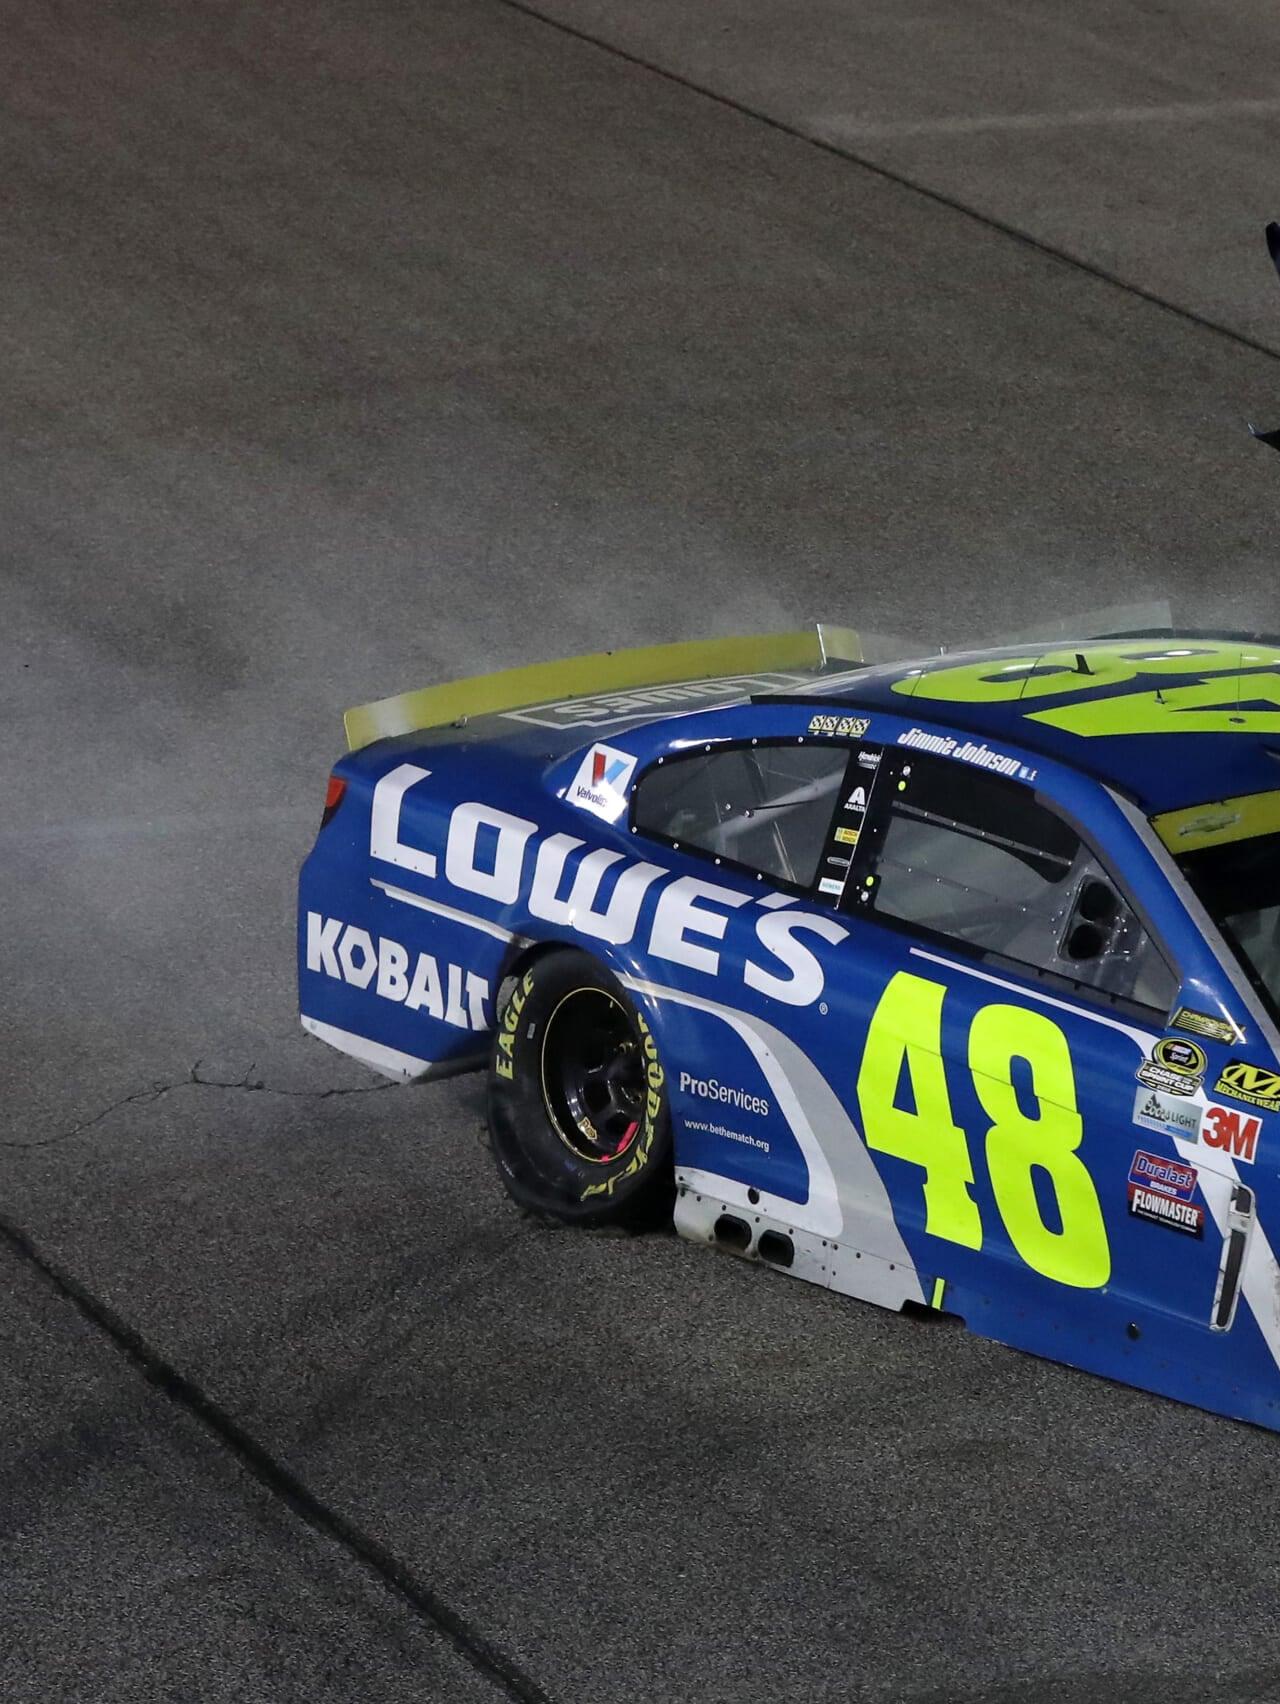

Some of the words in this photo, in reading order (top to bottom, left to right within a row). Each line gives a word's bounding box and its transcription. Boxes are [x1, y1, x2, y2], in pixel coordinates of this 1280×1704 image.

[554, 678, 782, 718] LOWE'S
[897, 727, 958, 756] Jimmie
[952, 742, 1022, 776] Johnson
[576, 785, 609, 808] Valvoli
[370, 763, 850, 1007] LOWE'S
[307, 911, 490, 1032] KOBALT
[495, 967, 536, 1080] EAGLE
[680, 1071, 770, 1116] ProServices
[1141, 1070, 1175, 1088] SPRINT
[1174, 1079, 1194, 1092] CUP
[1149, 1066, 1184, 1081] CHASE
[684, 1119, 770, 1153] www.bethematch.org
[857, 970, 1112, 1289] 48
[1171, 1112, 1197, 1129] LIGHT
[1202, 1106, 1260, 1161] 3M
[1136, 1155, 1192, 1187] Duralast
[1132, 1188, 1201, 1227] FLOWMASTER
